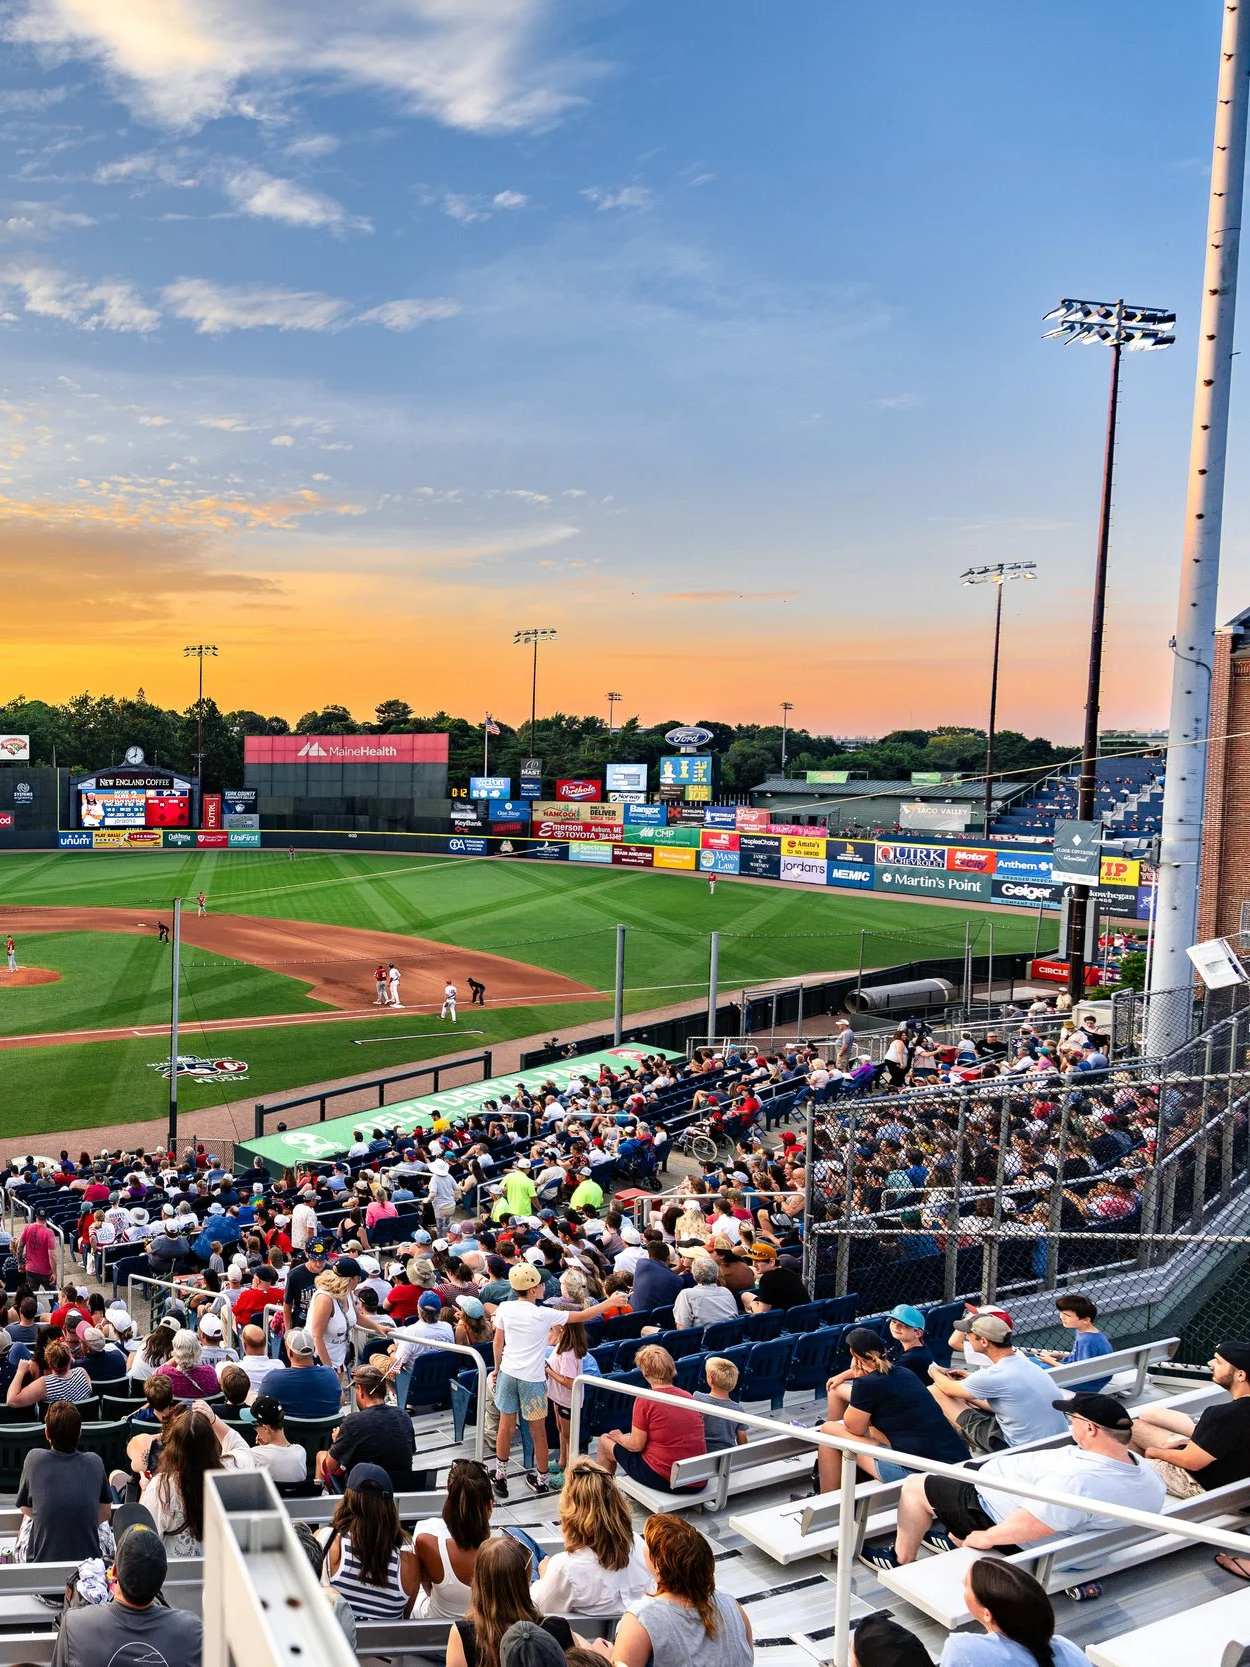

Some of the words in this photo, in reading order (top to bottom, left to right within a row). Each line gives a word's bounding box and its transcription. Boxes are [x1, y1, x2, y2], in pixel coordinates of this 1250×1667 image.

[674, 731, 699, 742] Ford
[329, 746, 397, 757] MaineHealth
[562, 785, 596, 795] Porthole
[630, 805, 660, 814] Bangor
[539, 822, 583, 836] Emerson
[655, 829, 674, 837] CMP
[61, 835, 89, 845] unum
[741, 838, 779, 846] PeoplesChoice
[715, 852, 738, 861] MANN
[878, 846, 943, 862] QUIRK
[955, 851, 988, 860] Motor
[718, 861, 734, 869] LAW
[782, 860, 825, 874] jordan's
[895, 858, 944, 868] CHEVROLET
[966, 860, 988, 870] City
[997, 860, 1038, 871] Anthem
[832, 869, 870, 881] MEMIC
[895, 874, 945, 888] Martin's
[948, 878, 982, 892] Point
[1001, 883, 1052, 900] Geiger
[1089, 890, 1135, 900] kowhegan
[1039, 966, 1068, 976] CIRCLE
[354, 1104, 441, 1136] DELTA
[442, 1075, 542, 1107] DENTAL
[540, 1061, 607, 1083] PARK
